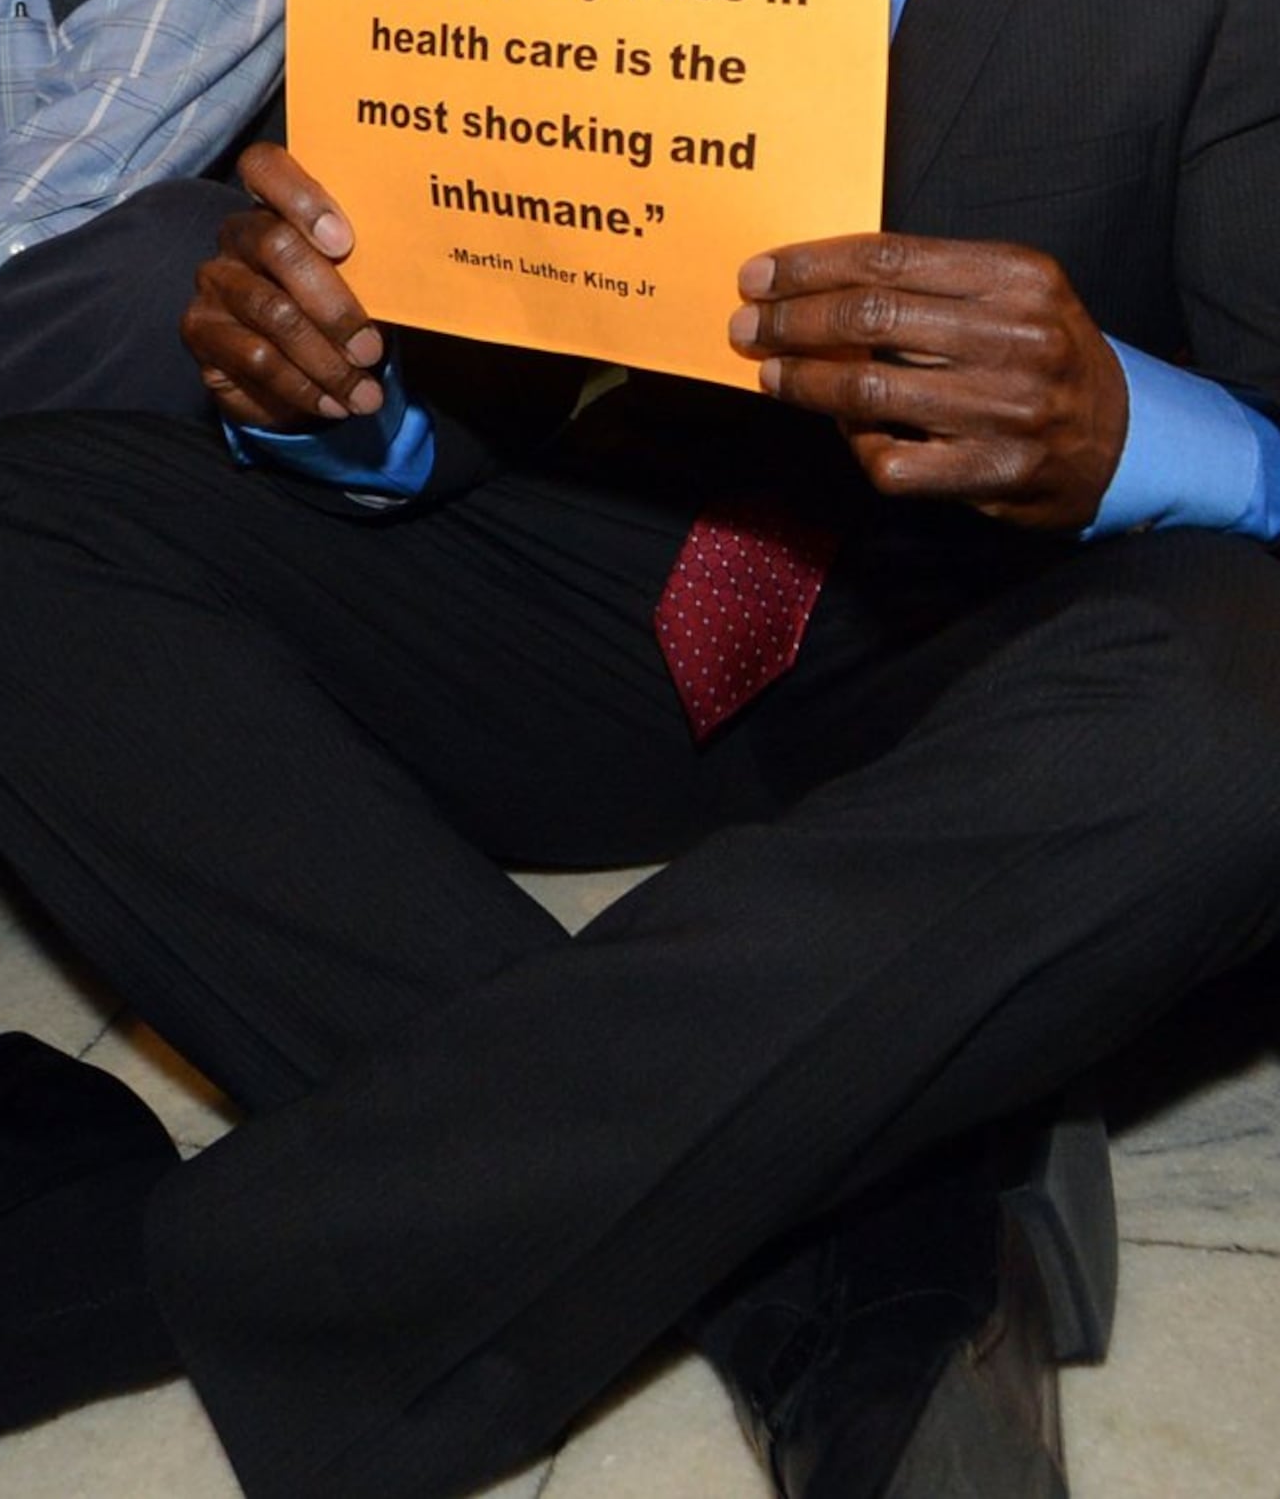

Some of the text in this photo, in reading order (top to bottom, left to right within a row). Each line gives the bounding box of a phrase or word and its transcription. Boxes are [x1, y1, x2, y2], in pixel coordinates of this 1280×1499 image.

[371, 16, 747, 85] health care is the
[357, 98, 757, 171] most shocking and
[430, 173, 665, 238] inhumane.”
[447, 247, 657, 298] -Martin Luther King Jr
